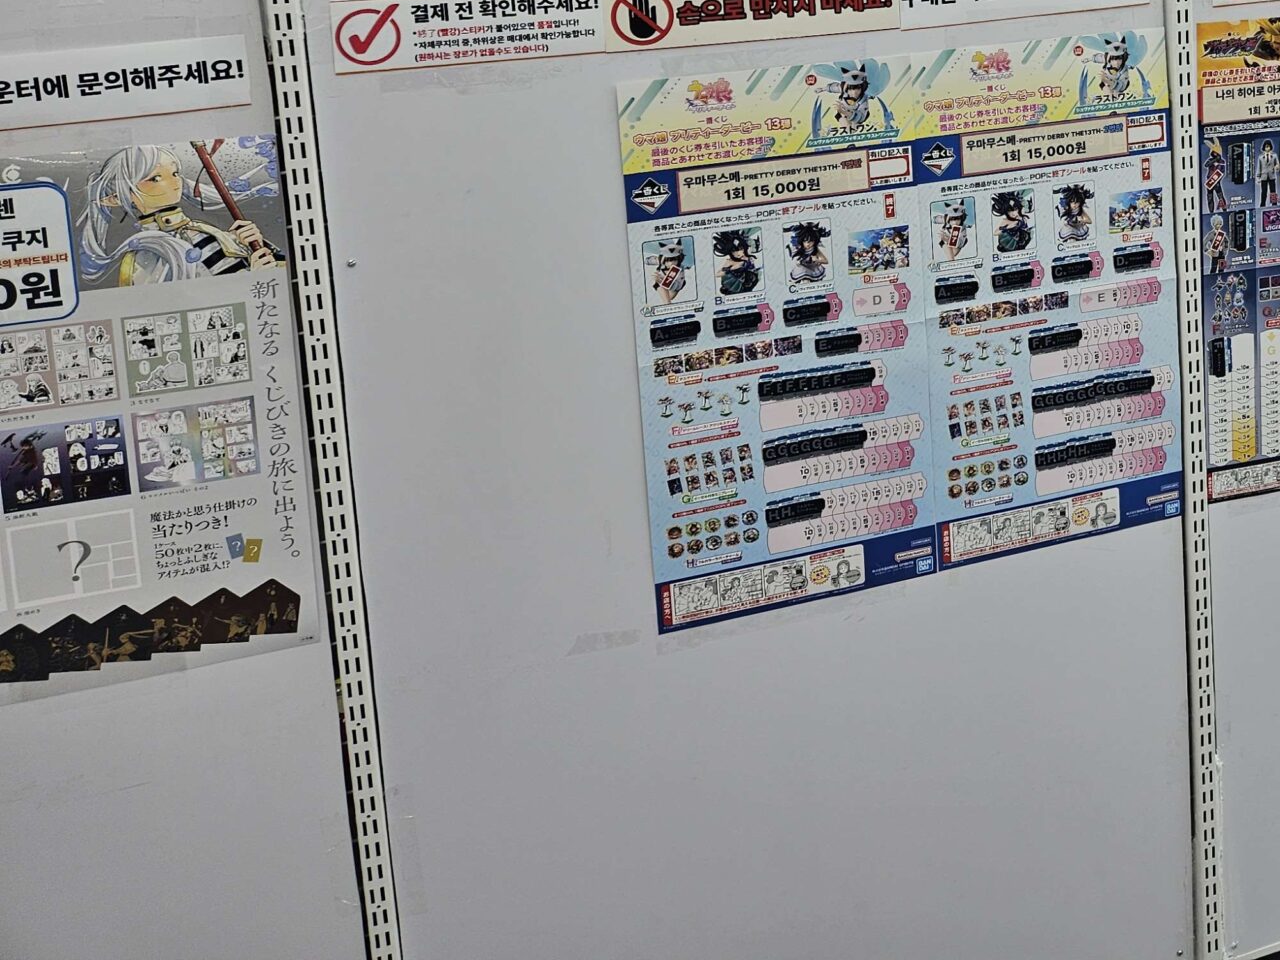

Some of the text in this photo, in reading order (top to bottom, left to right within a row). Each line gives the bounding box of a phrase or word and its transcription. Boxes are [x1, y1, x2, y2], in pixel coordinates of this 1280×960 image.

[410, 3, 449, 23] 결제
[454, 1, 473, 20] 전
[76, 60, 244, 97] 문의해주세요!
[1215, 88, 1235, 100] 나의
[1237, 84, 1265, 98] 히어로
[1248, 105, 1261, 116] 1회
[651, 137, 770, 158] 最後のくじ券を引いたお客様に
[652, 146, 775, 167] 商品とあわせてお渡しください。
[1003, 141, 1086, 163] 1회 15,000원
[724, 177, 820, 201] 1회 15,000원
[2, 227, 49, 251] 쿠지
[14, 253, 69, 266] 부탁드립니다
[250, 280, 301, 558] 新たなる くじびきの旅に出よう。
[150, 497, 258, 523] 魔法かと思う仕掛けの
[152, 515, 229, 539] 当たりつき!
[156, 552, 219, 569] ちょっとふしぎな
[157, 560, 231, 580] アイテムが混入!?
